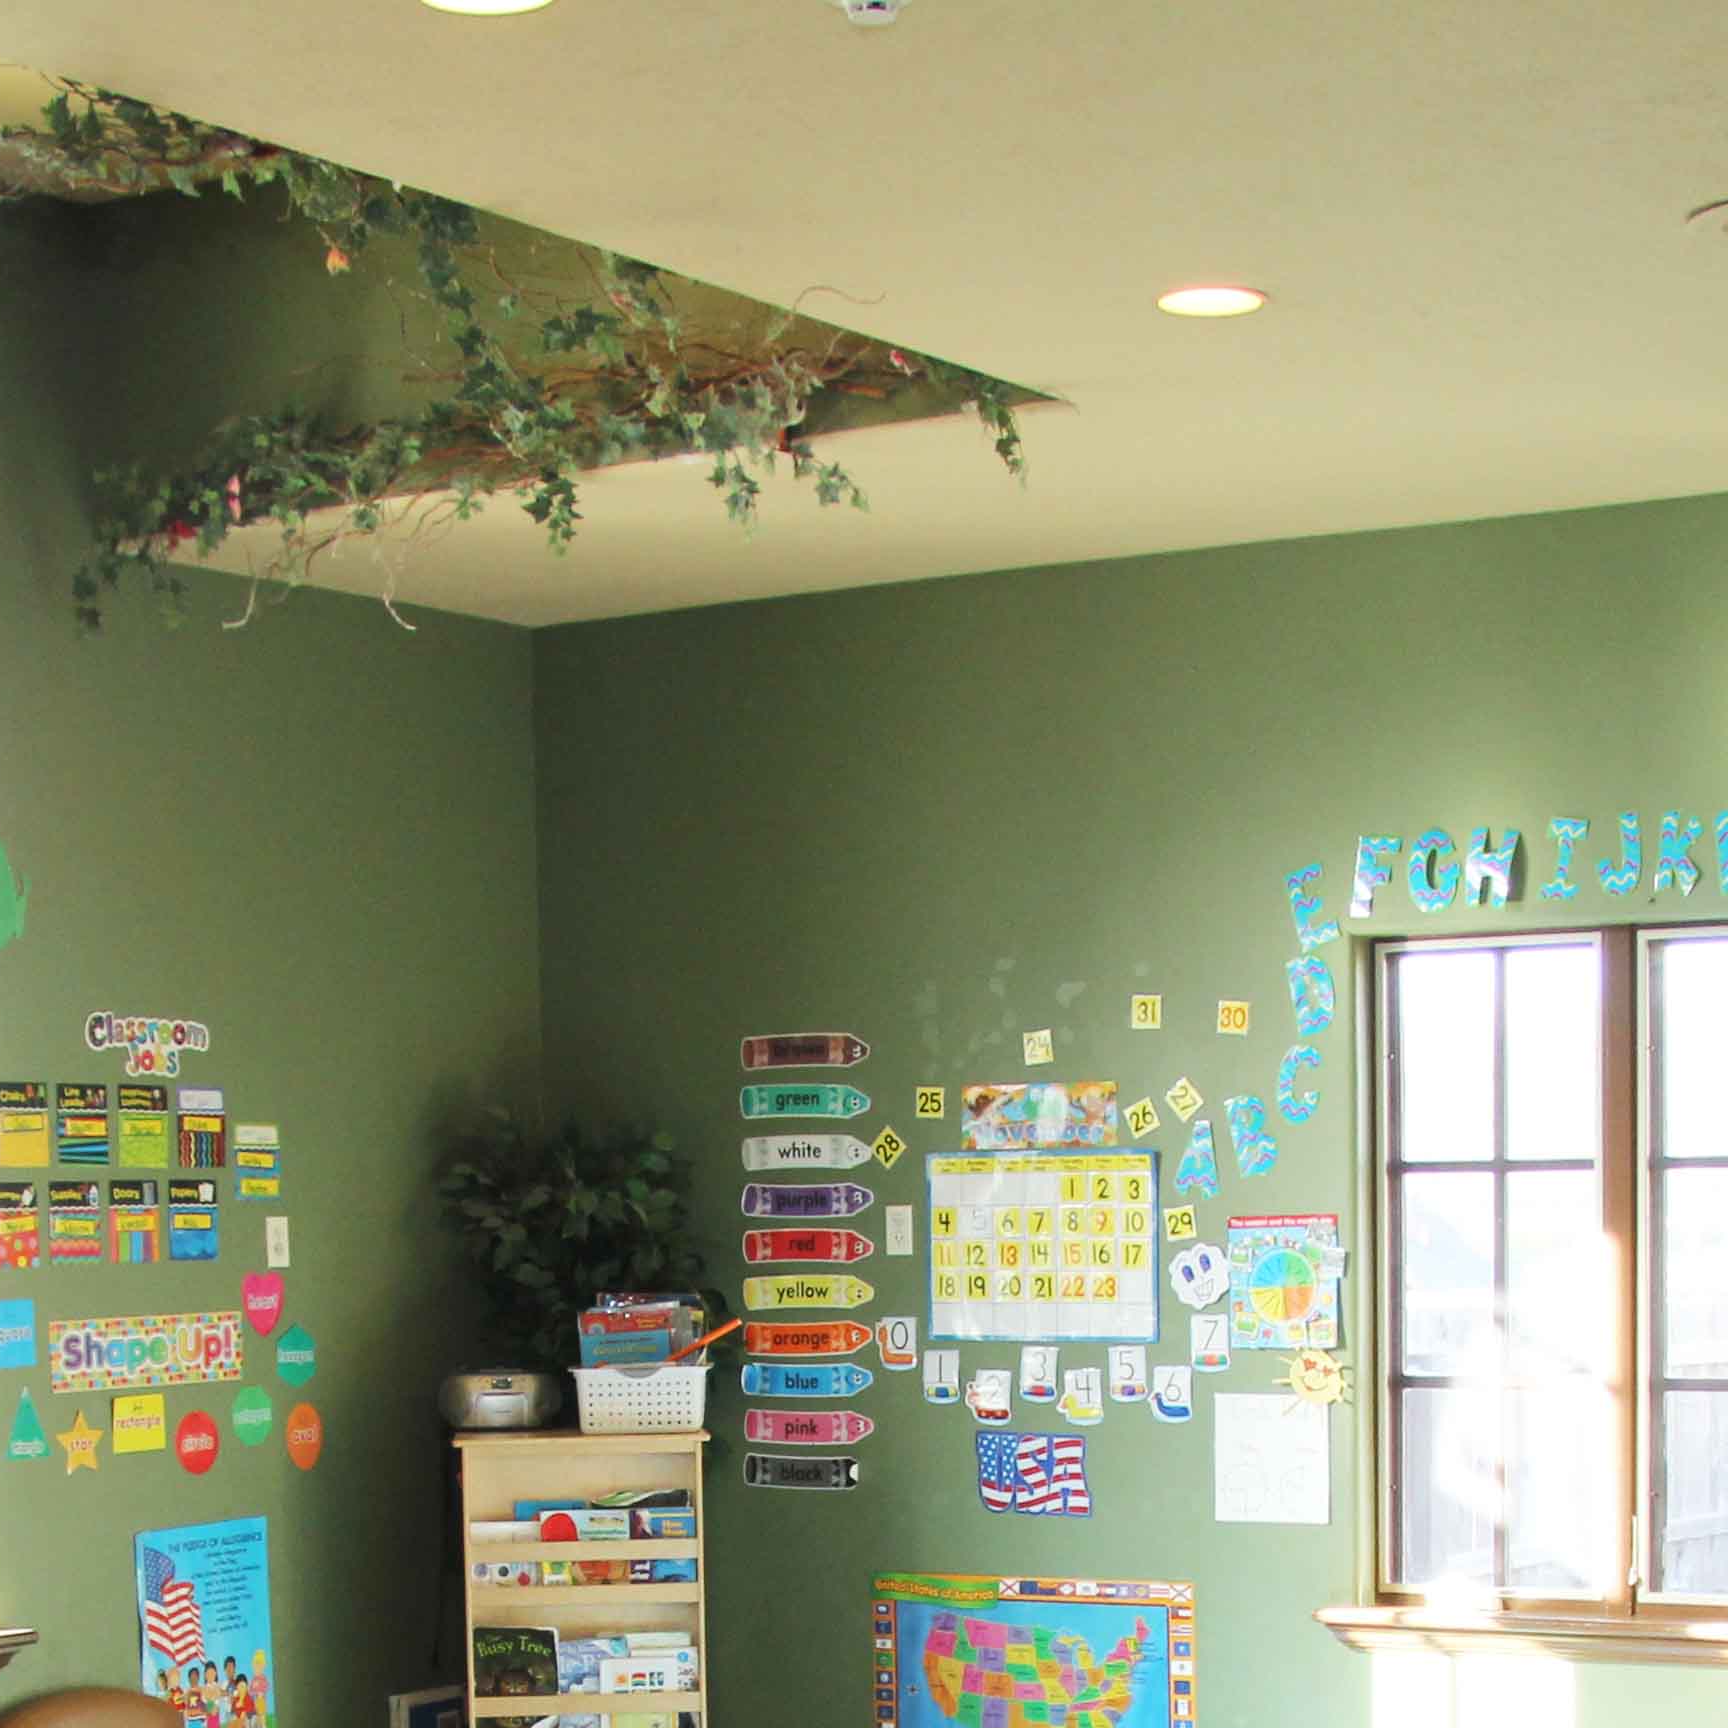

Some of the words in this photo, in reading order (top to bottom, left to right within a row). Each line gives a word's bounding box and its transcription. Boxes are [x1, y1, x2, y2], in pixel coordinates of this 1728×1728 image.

[1465, 826, 1521, 908] H
[1541, 817, 1589, 899] I
[1596, 811, 1642, 895] J
[1654, 809, 1703, 896] K
[1350, 834, 1402, 918] F
[1409, 827, 1460, 912] G
[1285, 861, 1342, 952] E
[1286, 955, 1336, 1036] D
[1136, 1001, 1156, 1023] 31
[1219, 1007, 1246, 1028] 30
[88, 1013, 208, 1047] Classroom
[1026, 1037, 1051, 1058] 24
[1171, 1085, 1197, 1112] 27
[1278, 1044, 1322, 1125] C
[775, 1092, 821, 1111] green
[918, 1092, 942, 1113] 25
[1129, 1109, 1155, 1133] 26
[777, 1141, 823, 1160] white
[875, 1133, 901, 1163] 28
[1224, 1095, 1279, 1178] B
[1175, 1119, 1219, 1200] A
[1097, 1178, 1109, 1199] 2
[1128, 1179, 1141, 1199] 3
[938, 1212, 951, 1233] 4
[1002, 1212, 1014, 1232] 6
[1032, 1212, 1045, 1232] 7
[1067, 1211, 1079, 1232] 8
[1095, 1211, 1108, 1231] 9
[1124, 1211, 1144, 1232] 10
[1168, 1211, 1193, 1235] 29
[789, 1235, 817, 1252] red
[936, 1245, 952, 1265] 11
[966, 1244, 985, 1265] 12
[999, 1245, 1018, 1265] 13
[1031, 1244, 1049, 1264] 14
[1063, 1244, 1082, 1264] 15
[1091, 1244, 1111, 1264] 16
[1124, 1244, 1143, 1265] 17
[776, 1281, 829, 1304] yellow
[937, 1275, 956, 1296] 18
[968, 1276, 986, 1296] 19
[999, 1274, 1021, 1297] 20
[1034, 1277, 1053, 1298] 21
[1062, 1276, 1084, 1297] 22
[1093, 1276, 1117, 1298] 23
[773, 1330, 830, 1350] orange
[890, 1320, 910, 1350] 0
[1202, 1319, 1220, 1350] 7
[62, 1331, 170, 1375] Shape
[177, 1325, 233, 1370] Up!
[1118, 1349, 1136, 1380] 5
[1031, 1351, 1049, 1381] 3
[784, 1372, 819, 1390] blue
[1074, 1376, 1094, 1405] 4
[1164, 1372, 1183, 1403] 6
[114, 1415, 161, 1430] rectangle
[784, 1419, 819, 1440] pink
[977, 1430, 1093, 1517] USA
[518, 1635, 553, 1657] Tree
